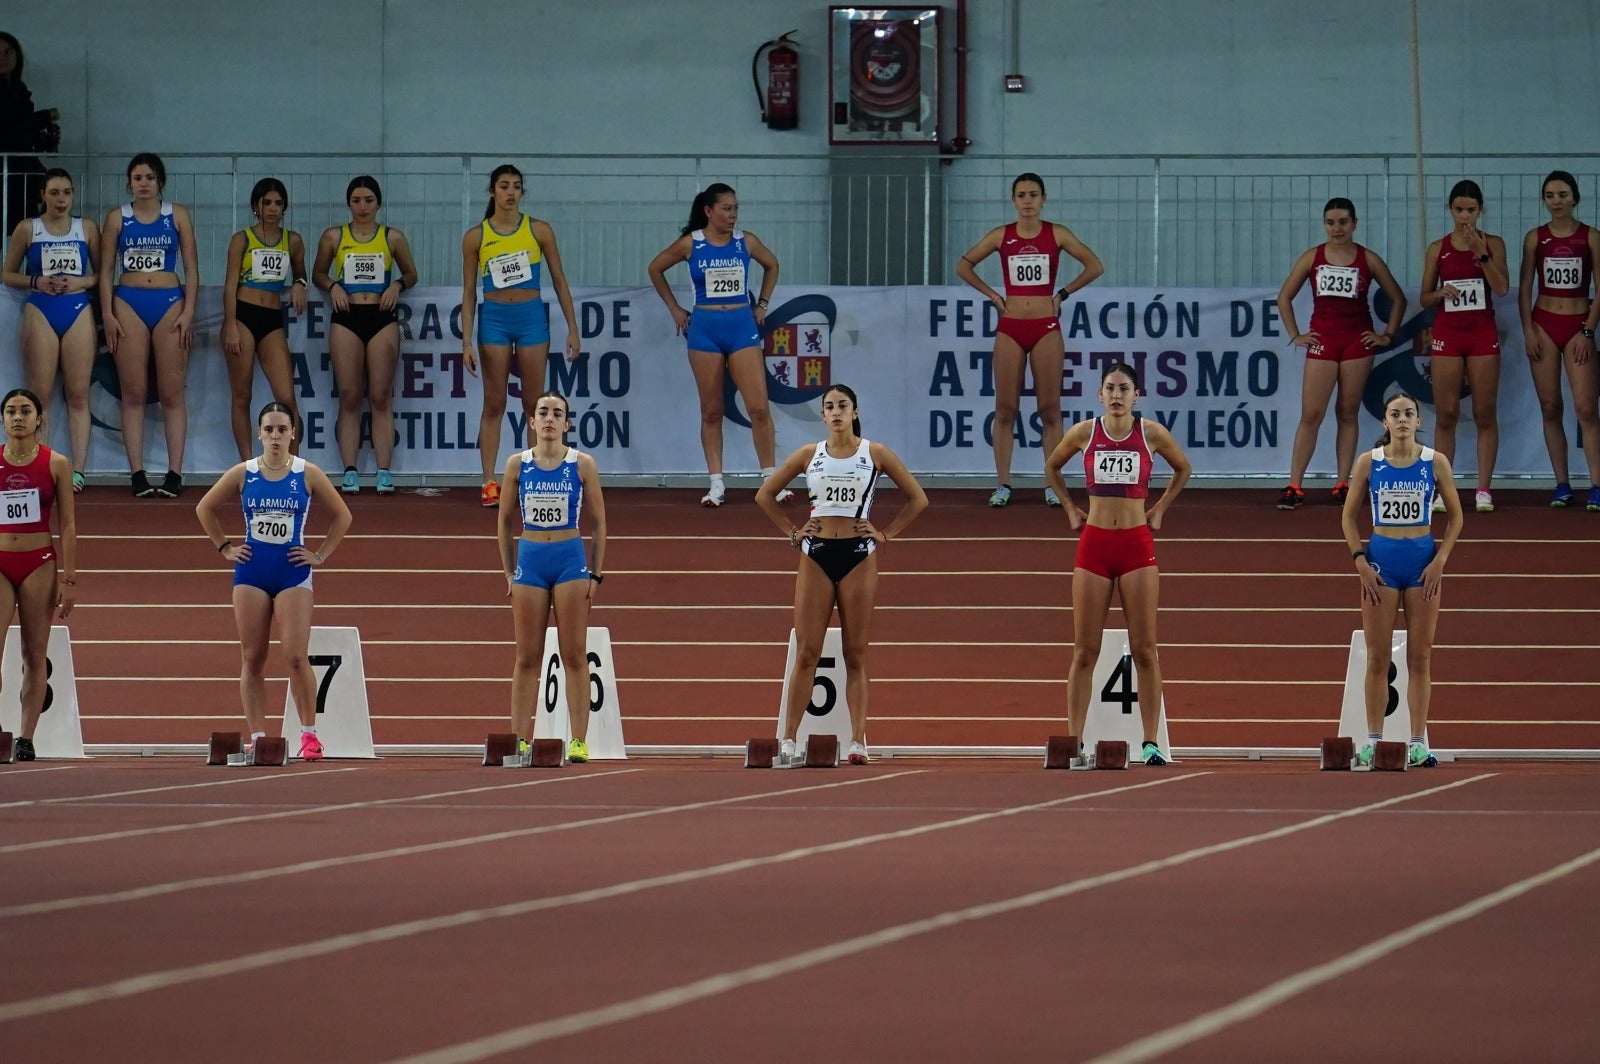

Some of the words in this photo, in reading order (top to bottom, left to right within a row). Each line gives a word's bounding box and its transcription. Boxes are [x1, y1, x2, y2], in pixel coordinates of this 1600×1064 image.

[125, 237, 134, 246] LA
[137, 234, 172, 246] ARMUÑA
[49, 259, 77, 271] 2473
[128, 256, 161, 270] 2664
[261, 256, 282, 270] 402
[355, 262, 375, 272] 5598
[501, 262, 521, 275] 4496
[698, 259, 707, 268] LA
[710, 257, 745, 268] ARMUÑA
[1017, 265, 1042, 282] 808
[1547, 268, 1579, 285] 2038
[713, 279, 740, 293] 2298
[1320, 275, 1353, 293] 6235
[581, 300, 631, 339] DE
[930, 294, 1199, 339] FEDACIÓN
[1230, 299, 1280, 338] DE
[291, 351, 630, 398] AETMO
[562, 403, 630, 449] EÓN
[930, 410, 974, 448] DE
[1187, 402, 1278, 448] LEÓN
[1100, 457, 1133, 473] 4713
[525, 481, 533, 490] LA
[535, 480, 573, 492] ARMUÑA
[1380, 481, 1389, 491] LA
[1392, 480, 1429, 492] ARMUÑA
[826, 487, 856, 502] 2183
[7, 503, 29, 519] 801
[247, 497, 257, 508] LA
[260, 497, 299, 510] ARMUÑA
[1382, 501, 1420, 520] 2309
[532, 508, 562, 522] 2663
[258, 521, 287, 537] 2700
[308, 655, 342, 713] 7
[545, 653, 570, 713] 6
[586, 652, 604, 712] 6
[805, 657, 837, 716] 5
[1101, 655, 1139, 714] 4
